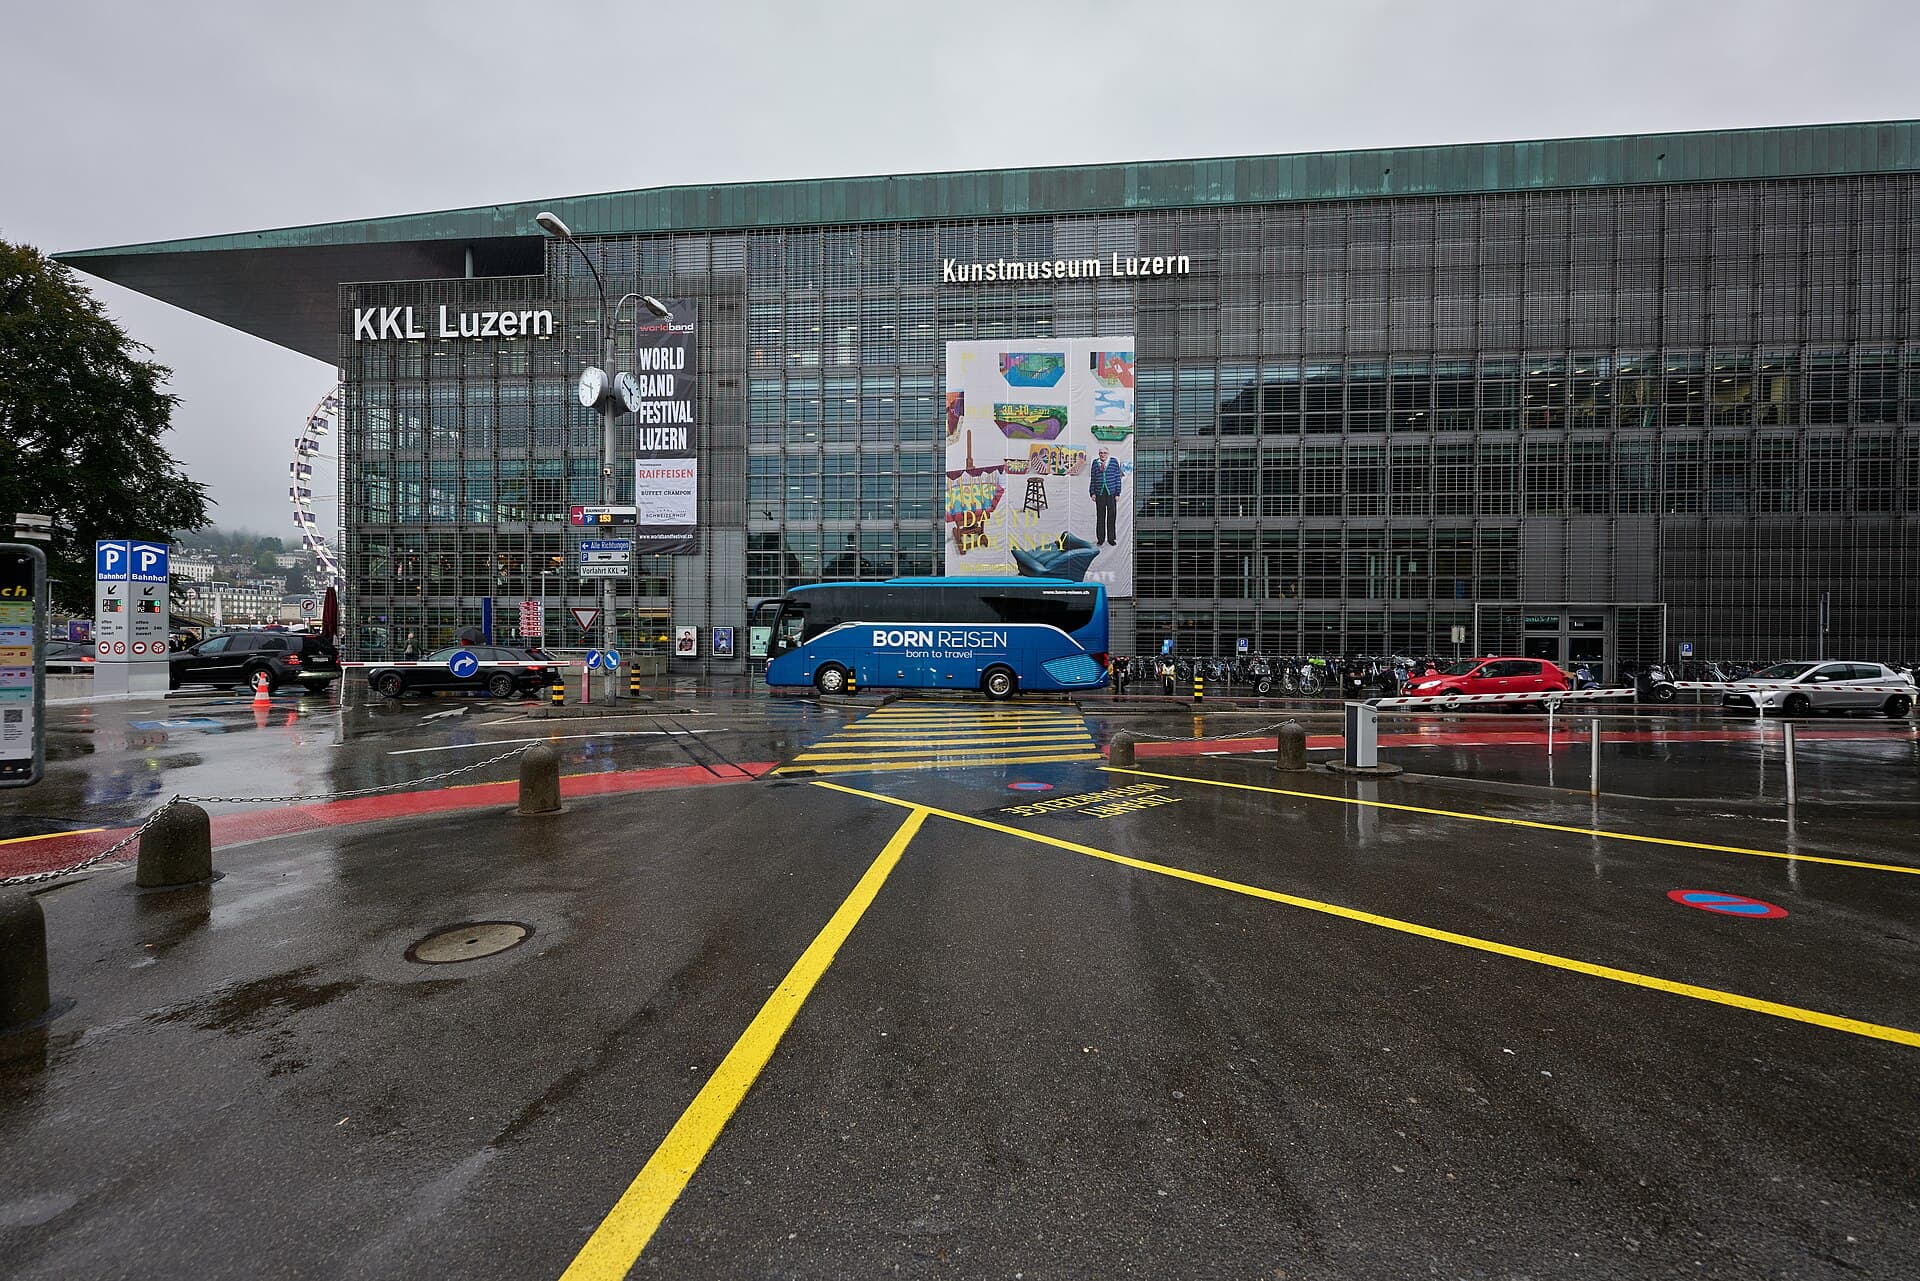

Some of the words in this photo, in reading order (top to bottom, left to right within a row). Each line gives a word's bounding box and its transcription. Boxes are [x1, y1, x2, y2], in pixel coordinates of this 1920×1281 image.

[943, 257, 1100, 283] Kunstmuseum
[1112, 252, 1190, 277] Luzern
[354, 306, 426, 341] KKL
[439, 305, 553, 338] Luzern
[639, 347, 685, 371] WORLD
[639, 374, 674, 397] BAND
[639, 400, 694, 424] FESTIVAL
[639, 427, 687, 451] LUZERN
[639, 469, 694, 479] RAIFFEISEN
[962, 510, 1038, 528] DAVID
[962, 532, 1068, 552] HOCKNEY
[132, 574, 166, 582] Bahnhof
[872, 630, 934, 647] BORN
[938, 631, 1007, 648] REISEN
[906, 650, 929, 658] born
[932, 650, 942, 658] to
[944, 650, 973, 658] travel
